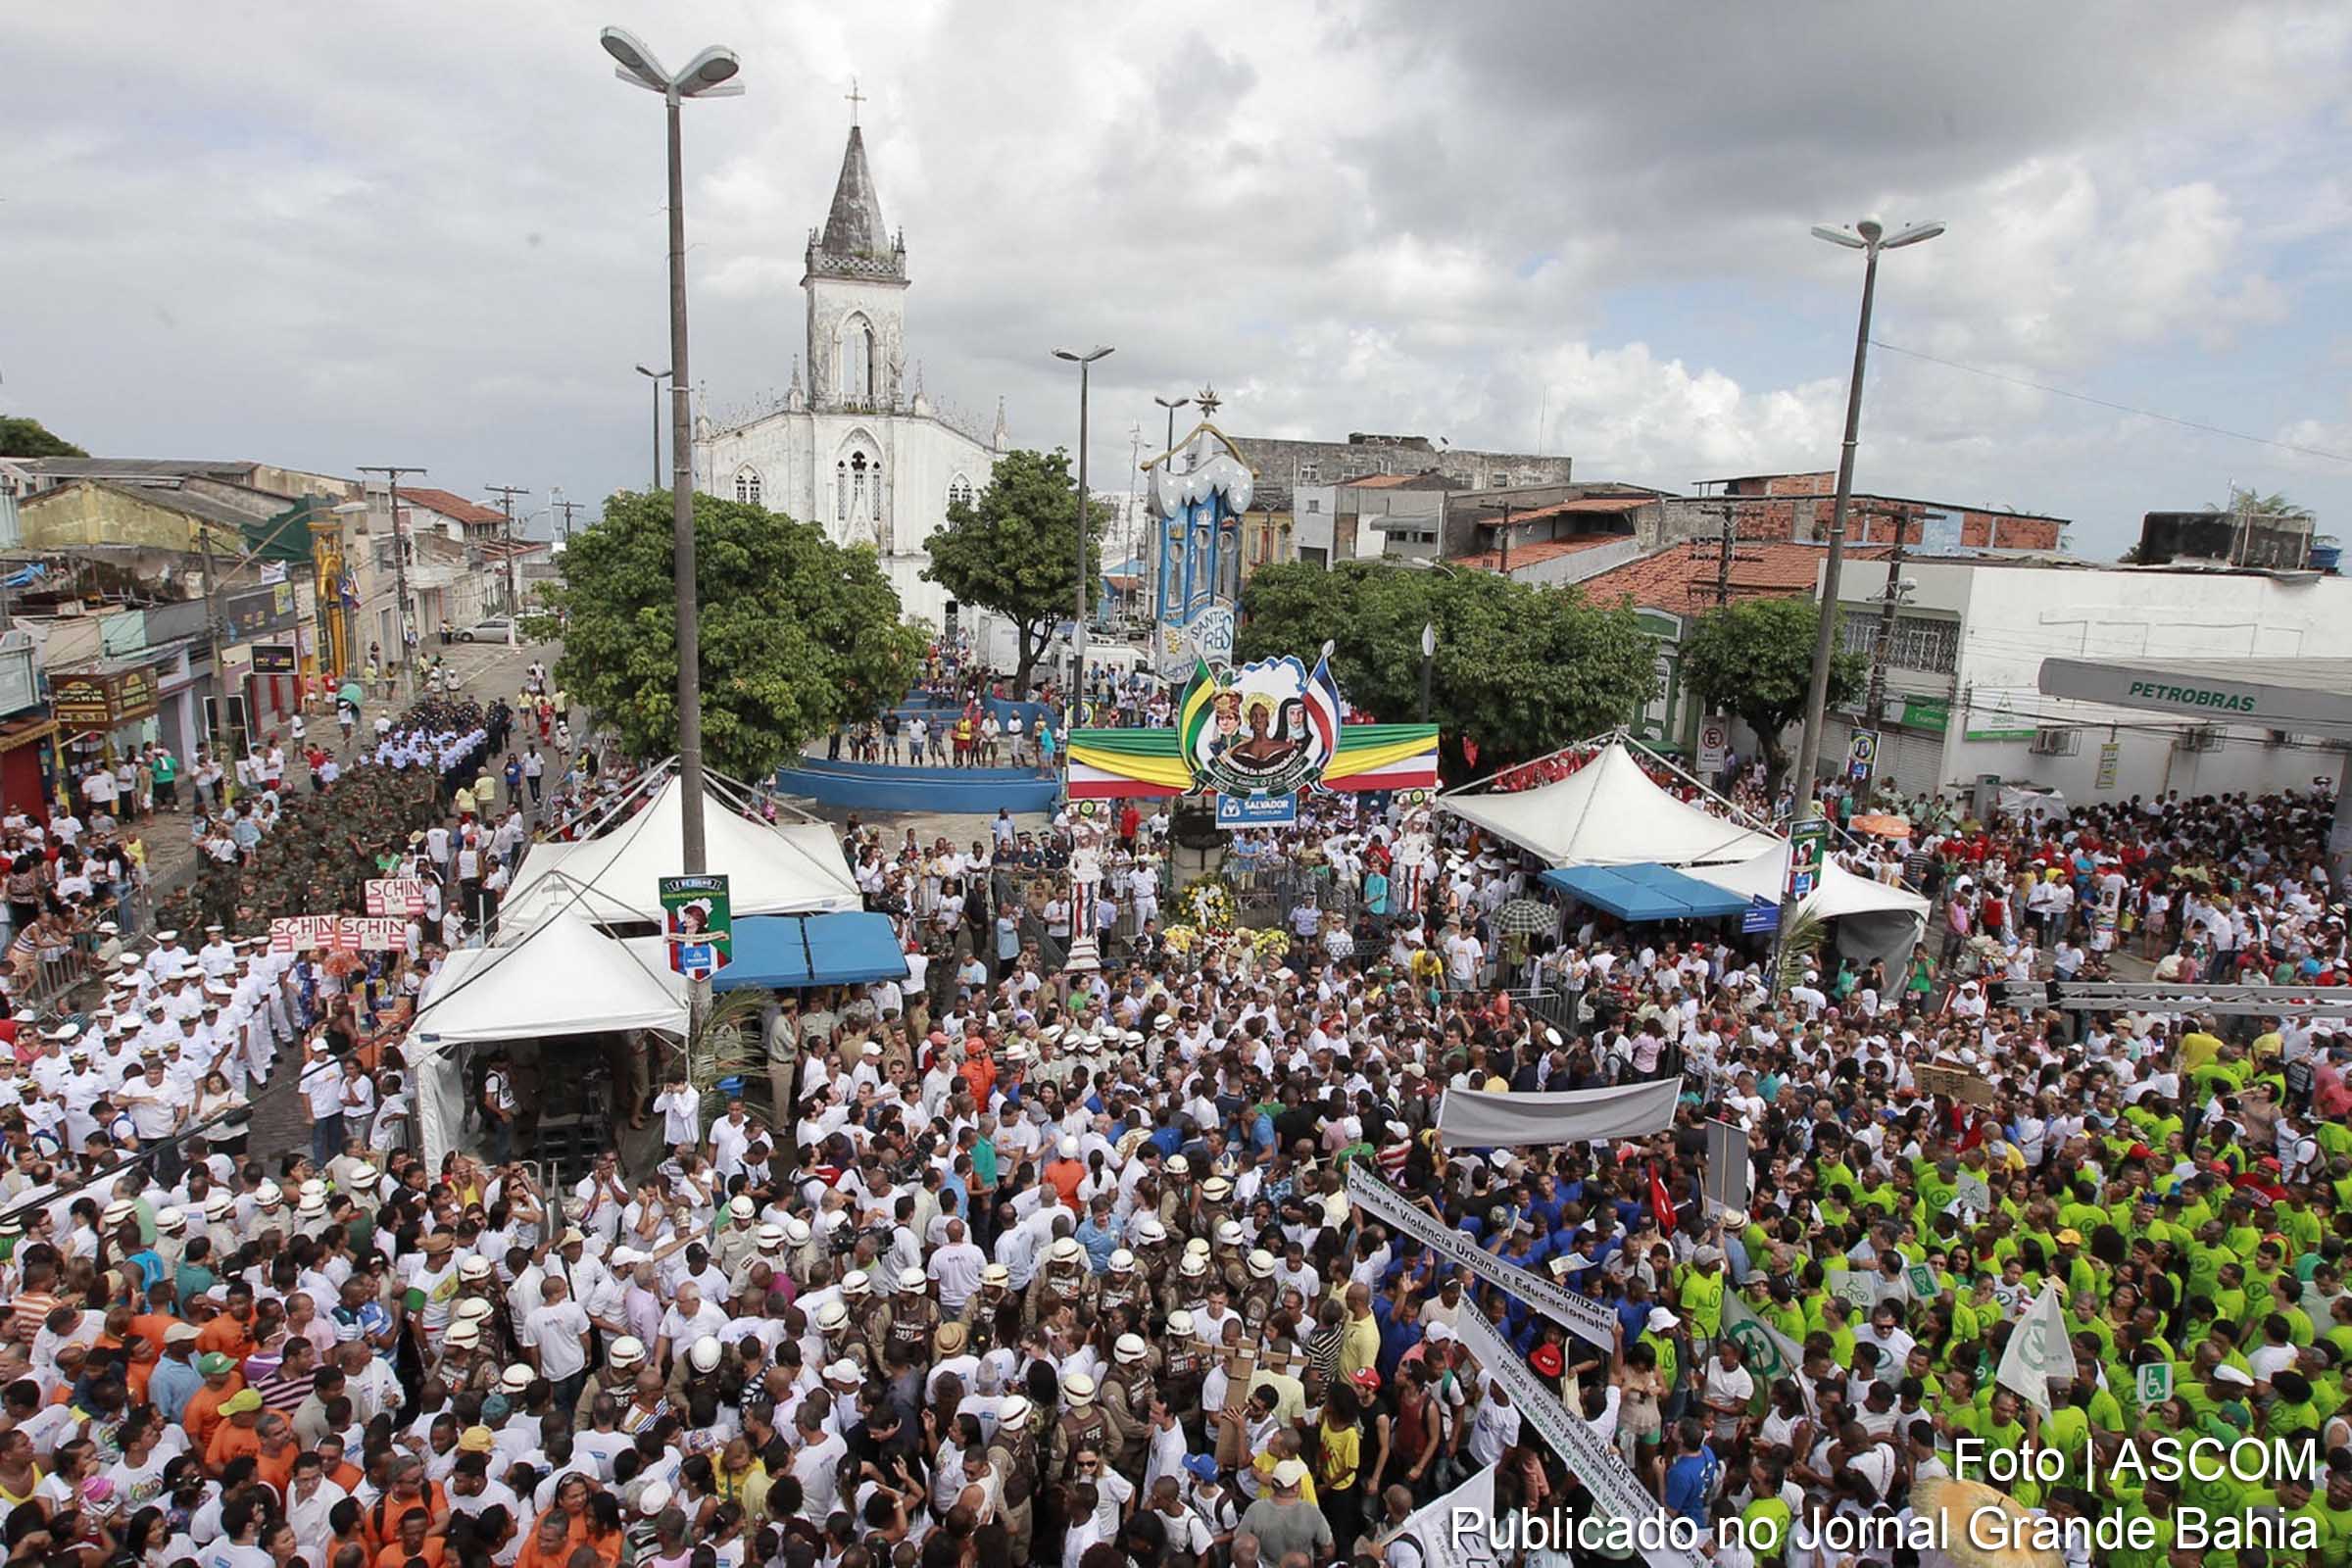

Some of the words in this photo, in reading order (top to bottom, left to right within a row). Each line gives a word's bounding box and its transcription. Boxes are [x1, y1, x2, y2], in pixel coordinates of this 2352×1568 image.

[2130, 682, 2256, 711] PETROBRAS
[1244, 800, 1290, 810] SALVADOR
[369, 880, 422, 898] SCHIN
[273, 916, 334, 935] SCHIN
[341, 919, 407, 935] SCHIN
[1347, 1177, 1382, 1205] Chega
[1382, 1199, 1397, 1214] de
[1453, 1244, 1500, 1275] Urbana
